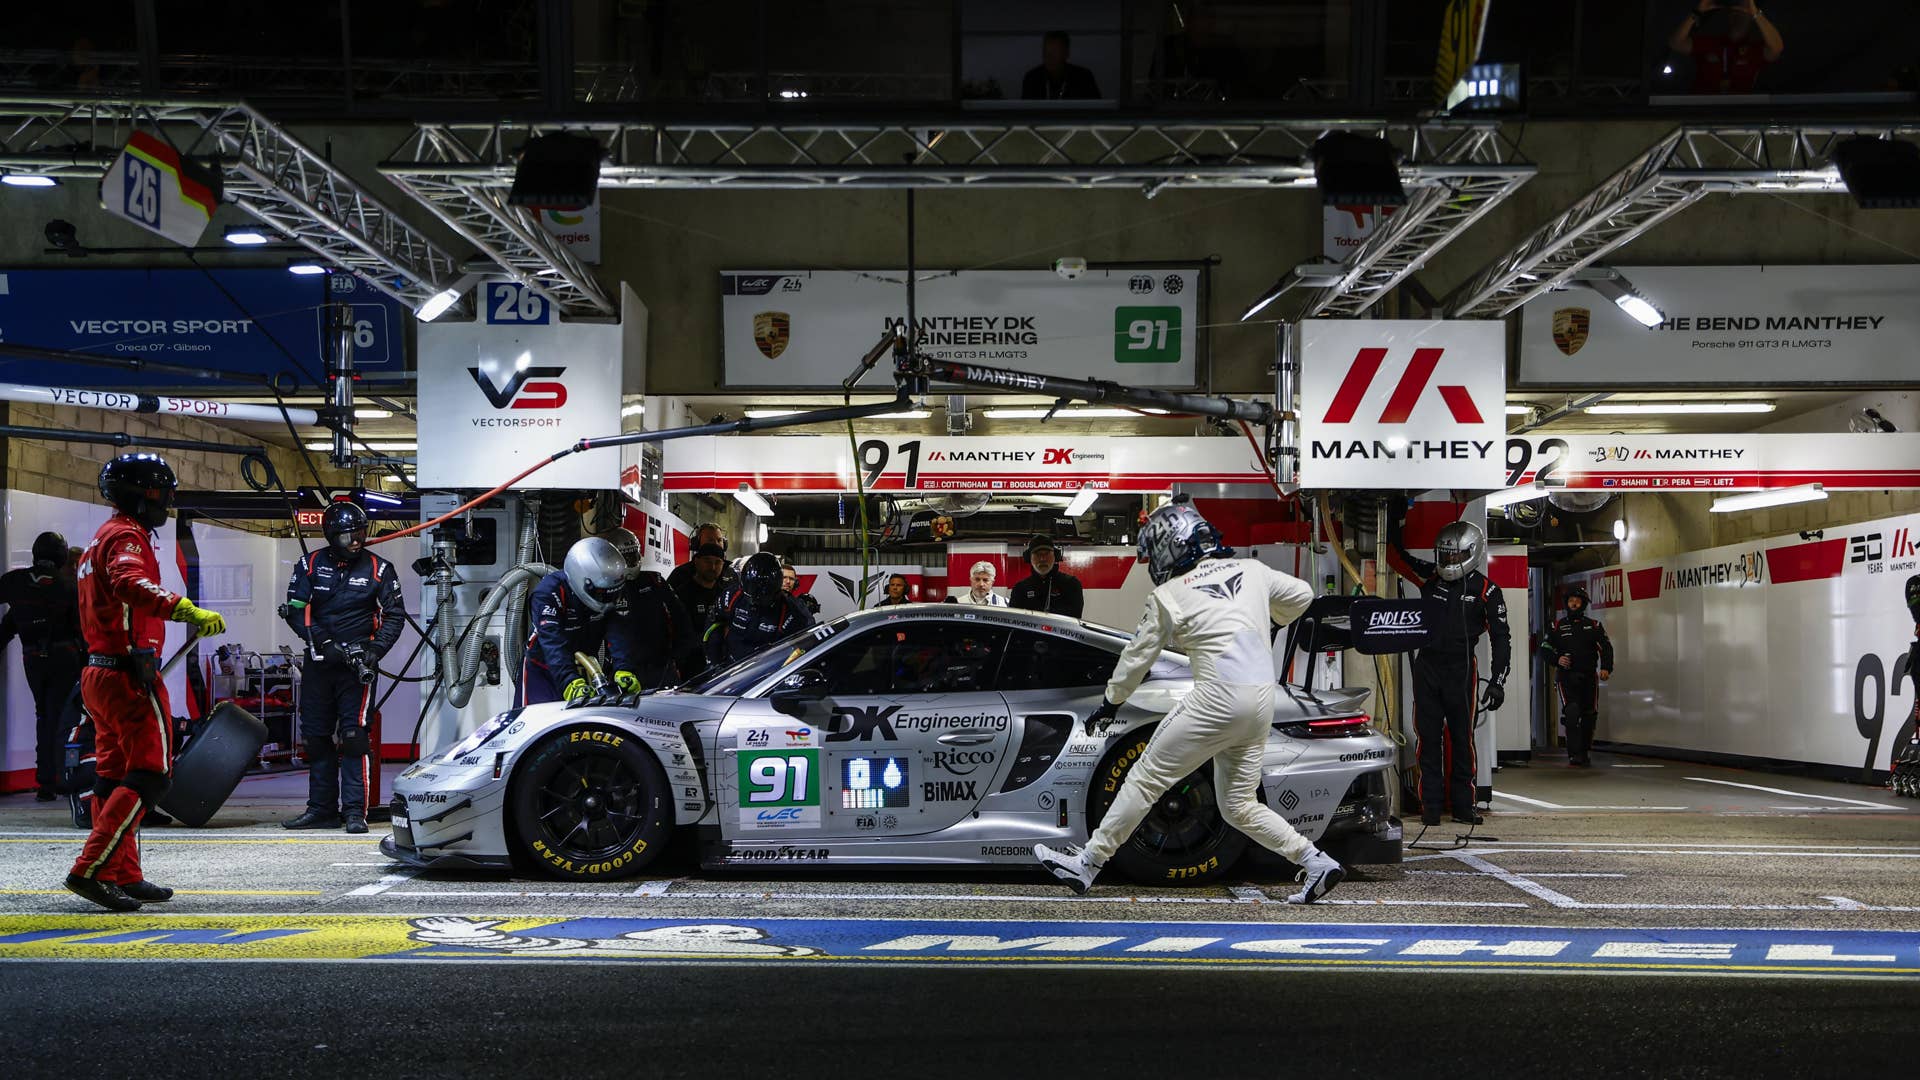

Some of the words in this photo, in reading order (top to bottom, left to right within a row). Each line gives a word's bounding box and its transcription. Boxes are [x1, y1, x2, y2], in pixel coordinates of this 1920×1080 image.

[128, 159, 158, 223] 26
[555, 232, 590, 244] ergies
[1334, 237, 1366, 247] Total
[1130, 279, 1152, 290] FIA
[494, 285, 543, 321] 26
[70, 320, 168, 334] VECTOR
[172, 320, 253, 334] SPORT
[1004, 317, 1035, 330] DK
[1648, 317, 1690, 331] HE
[1696, 317, 1760, 331] BEND
[1765, 316, 1885, 330] MANTHEY
[882, 332, 1038, 345] GINEERING
[1127, 320, 1168, 350] 91
[115, 343, 148, 352] Oreca
[173, 343, 211, 352] Gibson
[1692, 340, 1735, 349] Porsche
[1738, 340, 1754, 348] 911
[1756, 340, 1779, 348] GT3
[1781, 340, 1789, 348] R
[1792, 340, 1832, 348] LMGT3
[936, 351, 952, 359] 911
[954, 351, 977, 359] GT3
[979, 351, 987, 359] R
[988, 351, 1028, 359] LMGT3
[967, 367, 1048, 390] MANTHEY
[50, 388, 132, 409] VECTOR
[168, 398, 229, 416] SPORT
[472, 418, 562, 427] VECTORSPORT
[1312, 440, 1494, 459] MANTHEY
[858, 439, 922, 489] 91
[949, 451, 1036, 461] MANTHEY
[1042, 448, 1075, 465] DK
[1072, 452, 1105, 461] Engineering
[1506, 438, 1570, 487] 92
[1656, 449, 1745, 459] MANTHEY
[941, 481, 988, 489] COTTINGHAM
[1010, 481, 1063, 489] BOGUSLAVSKIY
[1867, 563, 1883, 574] YEARS
[1890, 562, 1917, 572] MANTHEY
[1677, 563, 1732, 588] MANTHEY
[1592, 575, 1622, 604] MOTUL
[1369, 611, 1422, 626] ENDLESS
[649, 718, 676, 728] RIEDEL
[825, 705, 904, 742] DK
[895, 712, 1008, 733] Engineering
[570, 731, 624, 747] EAGLE
[1069, 744, 1097, 752] ENDLESS
[933, 748, 994, 768] Ricco
[1112, 742, 1147, 777] GOOD
[1340, 749, 1385, 762] GOODYEAR
[748, 755, 809, 803] 91
[408, 792, 447, 804] GOODYEAR
[924, 781, 978, 802] BiMAX
[1310, 788, 1330, 798] IPA
[757, 808, 802, 820] WEC
[1288, 814, 1324, 826] ODYEAR
[856, 817, 875, 827] FIA
[533, 840, 633, 873] GOODYEAR
[730, 846, 830, 860] GOODYEAR
[981, 846, 1033, 856] RACEBORN
[1167, 856, 1219, 879] EAGLE
[862, 934, 1920, 962] MICHEL
